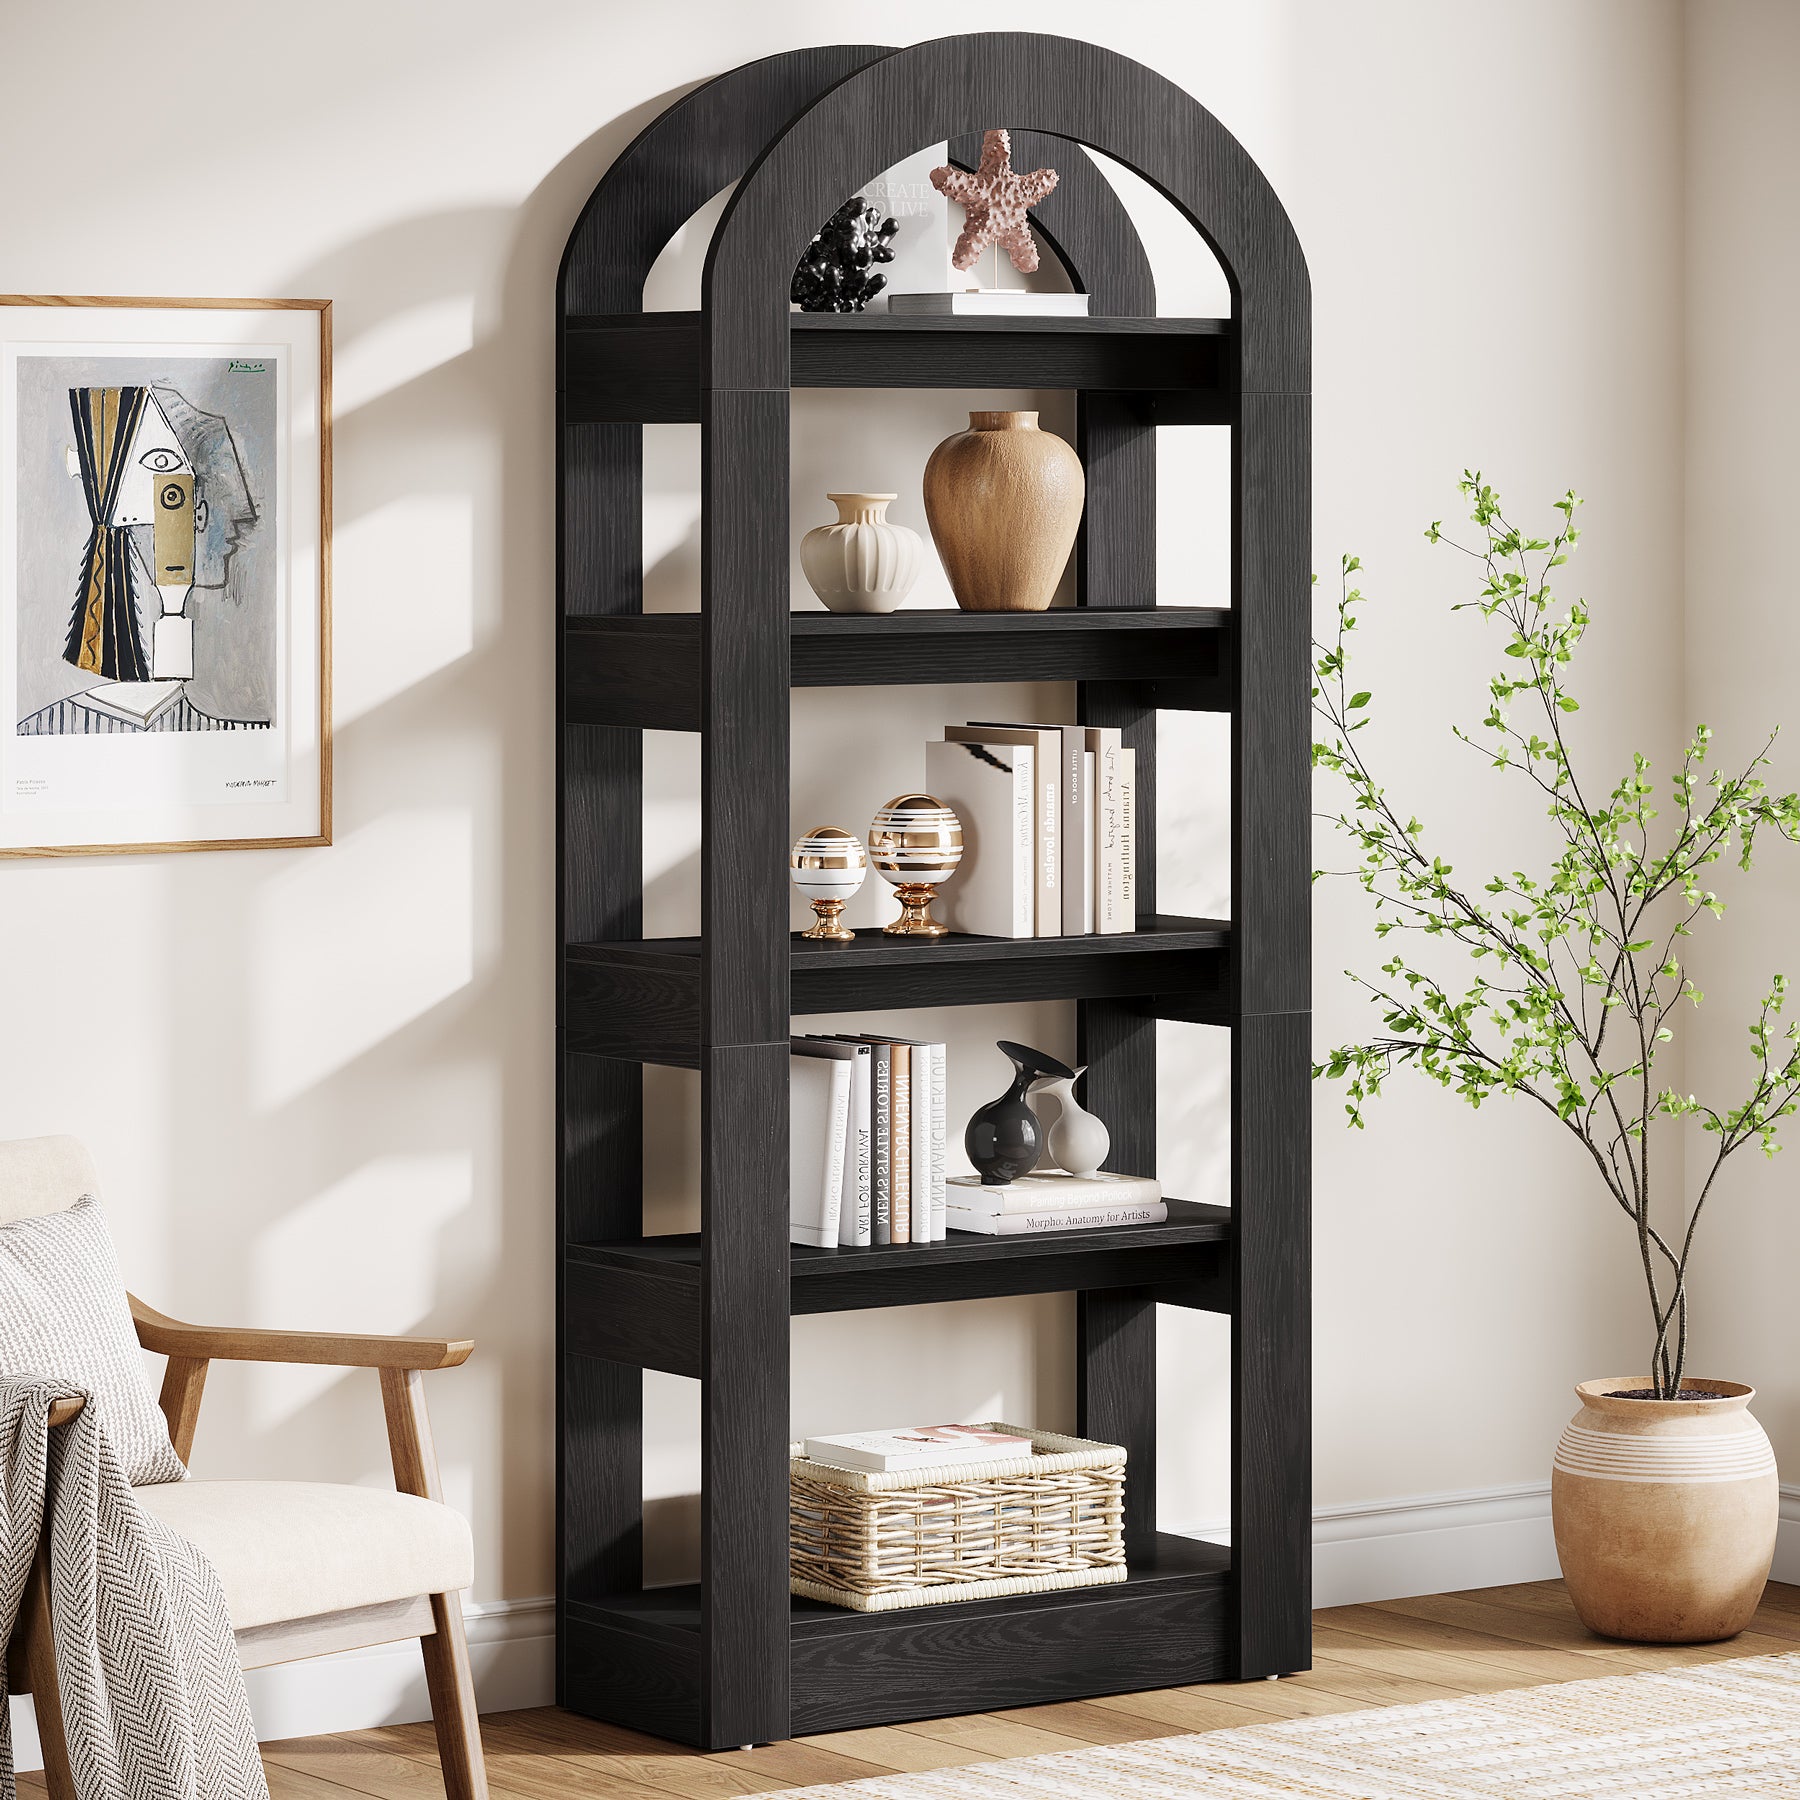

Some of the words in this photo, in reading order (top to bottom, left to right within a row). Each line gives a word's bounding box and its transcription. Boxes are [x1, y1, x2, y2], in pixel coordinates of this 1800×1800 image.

[863, 182, 929, 199] CREATE
[891, 200, 929, 217] LIVE
[1030, 1194, 1064, 1208] Painting
[1068, 1192, 1100, 1207] Beyond
[1102, 1190, 1132, 1202] Pollock
[1026, 1216, 1064, 1230] Morpho:
[1066, 1214, 1105, 1226] Anatomy
[1107, 1212, 1120, 1223] for
[1121, 1210, 1150, 1221] Artists
